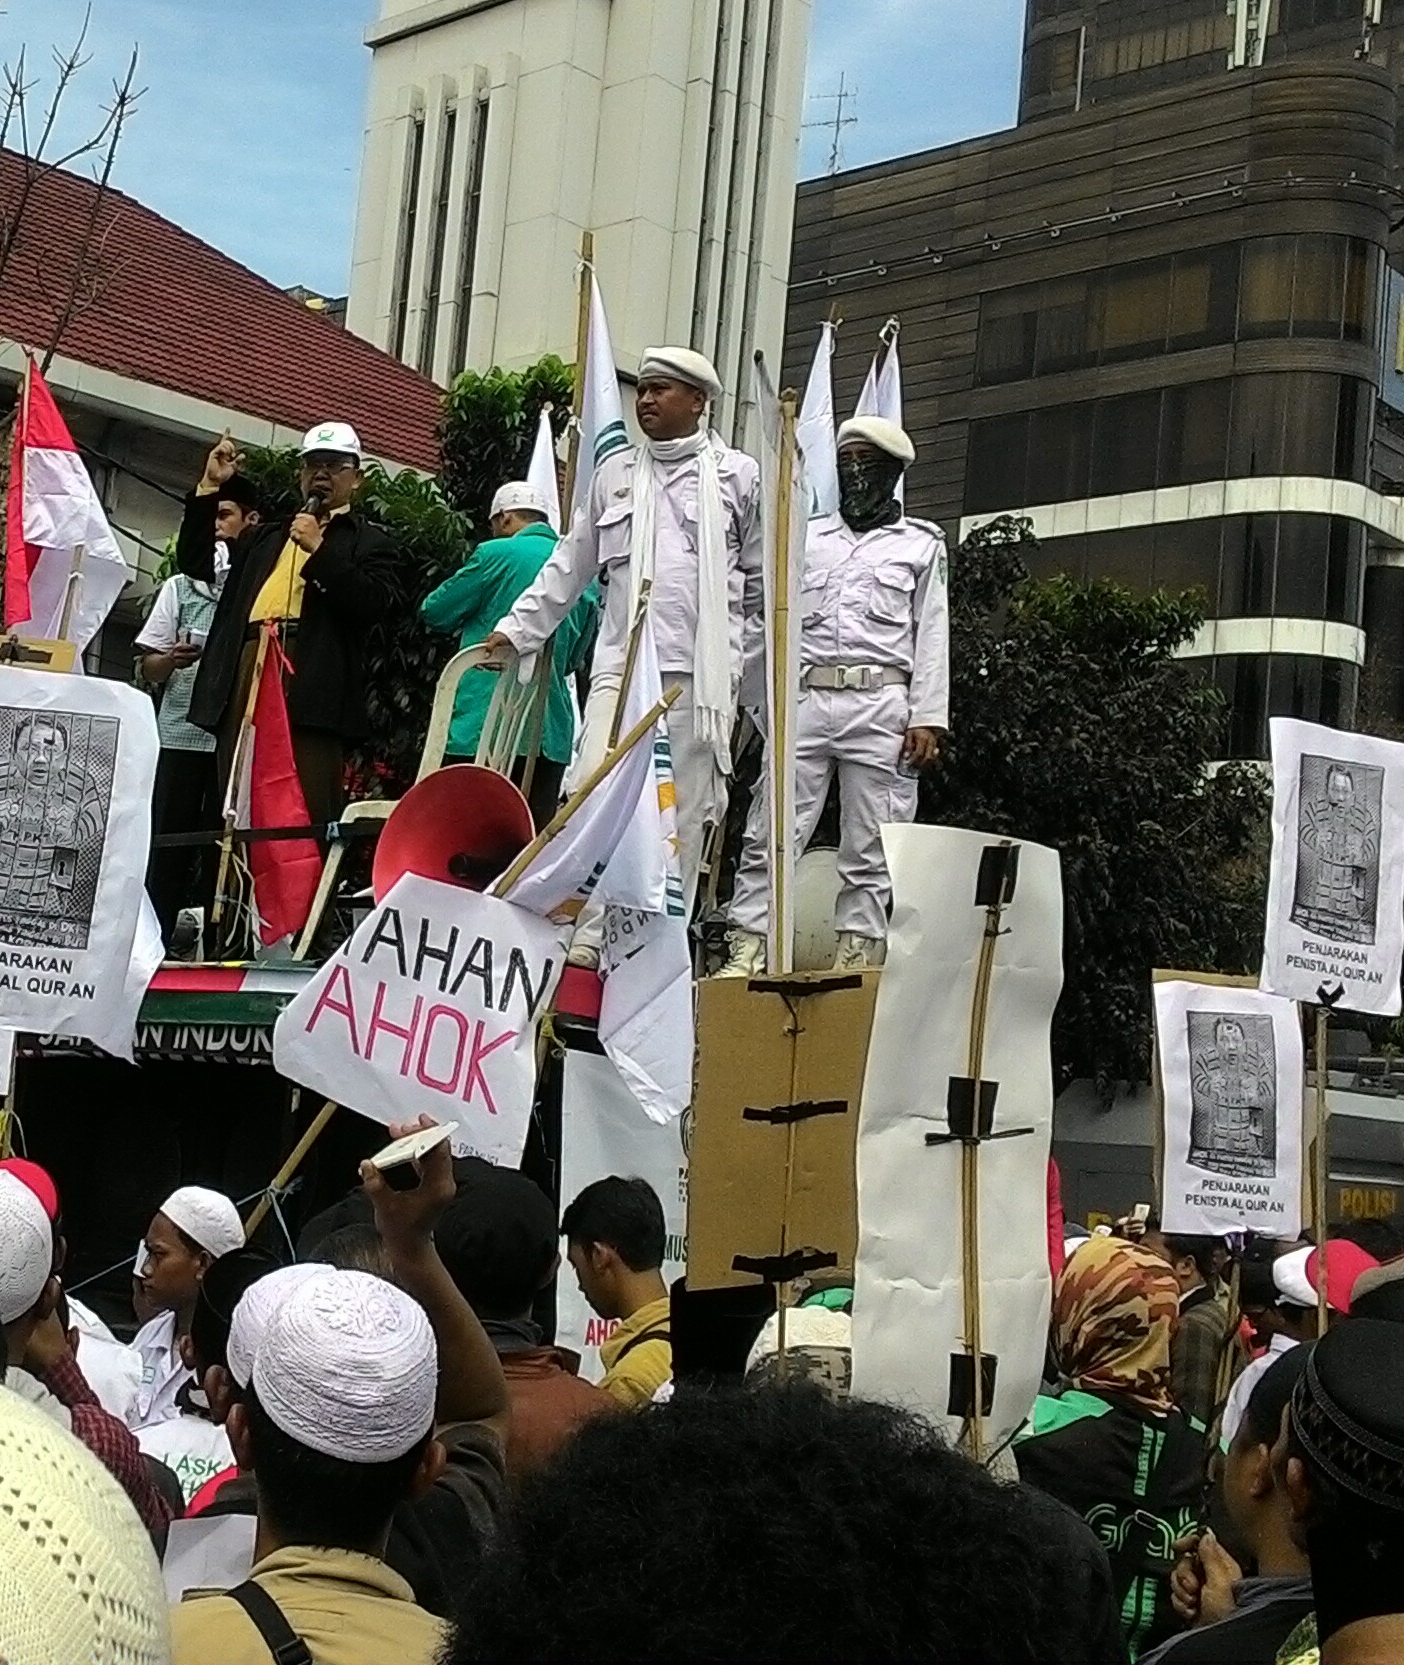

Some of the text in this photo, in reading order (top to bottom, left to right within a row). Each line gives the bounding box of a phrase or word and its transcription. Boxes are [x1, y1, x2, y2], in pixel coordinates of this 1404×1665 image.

[1302, 940, 1368, 964] PENJARAKAN
[1286, 954, 1328, 974] PENISTA
[304, 963, 519, 1115] AHOK
[1201, 1179, 1271, 1196] PENJARAKAN
[1185, 1193, 1230, 1208] PENISTA
[1230, 1200, 1244, 1209] AL
[1339, 1187, 1396, 1218] POLISI
